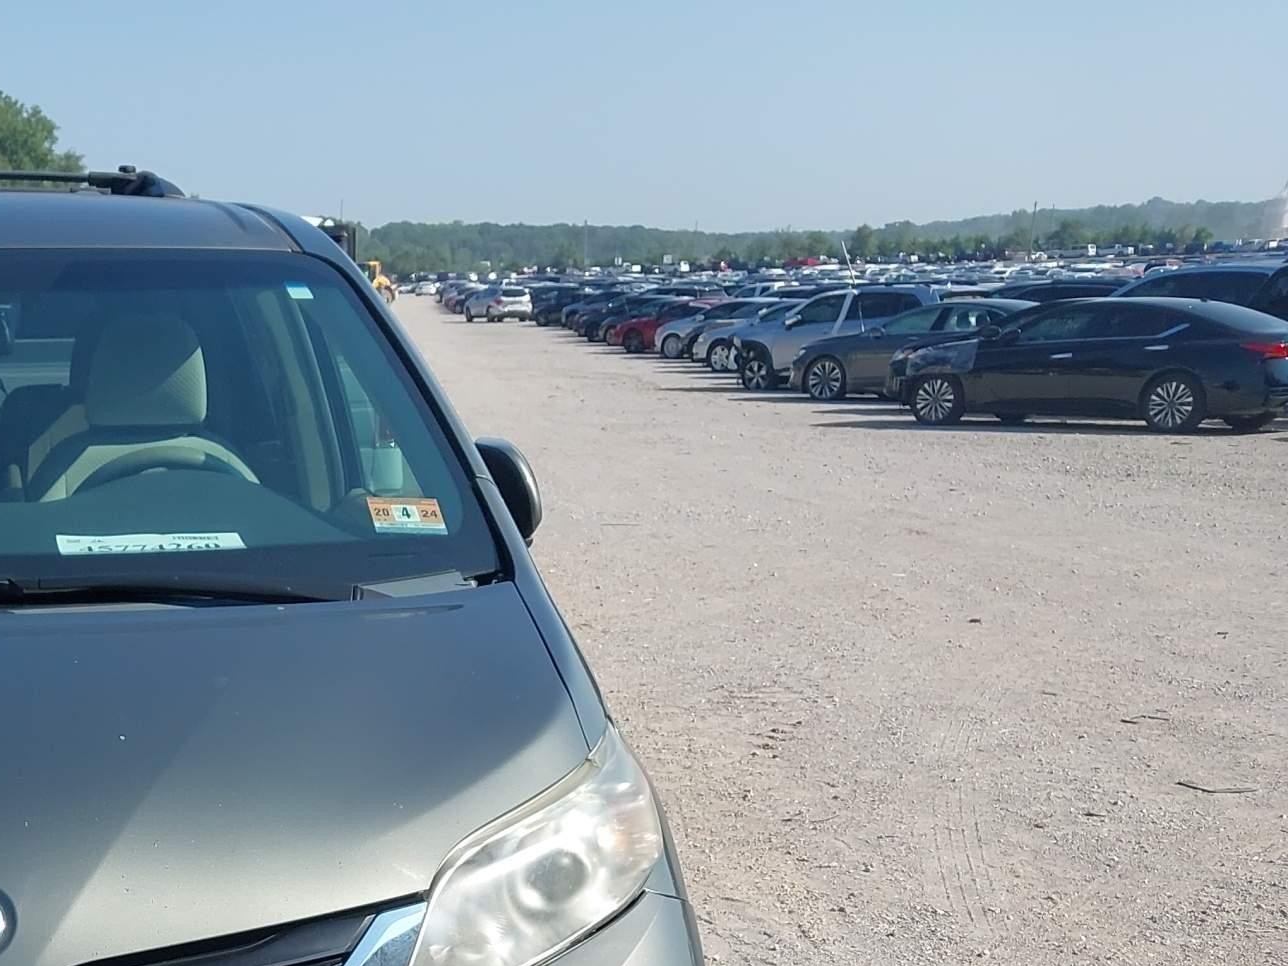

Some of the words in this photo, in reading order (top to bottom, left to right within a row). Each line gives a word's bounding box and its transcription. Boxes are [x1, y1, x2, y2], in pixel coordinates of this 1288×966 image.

[373, 507, 390, 517] 20
[401, 506, 412, 519] 4
[420, 509, 438, 519] 24
